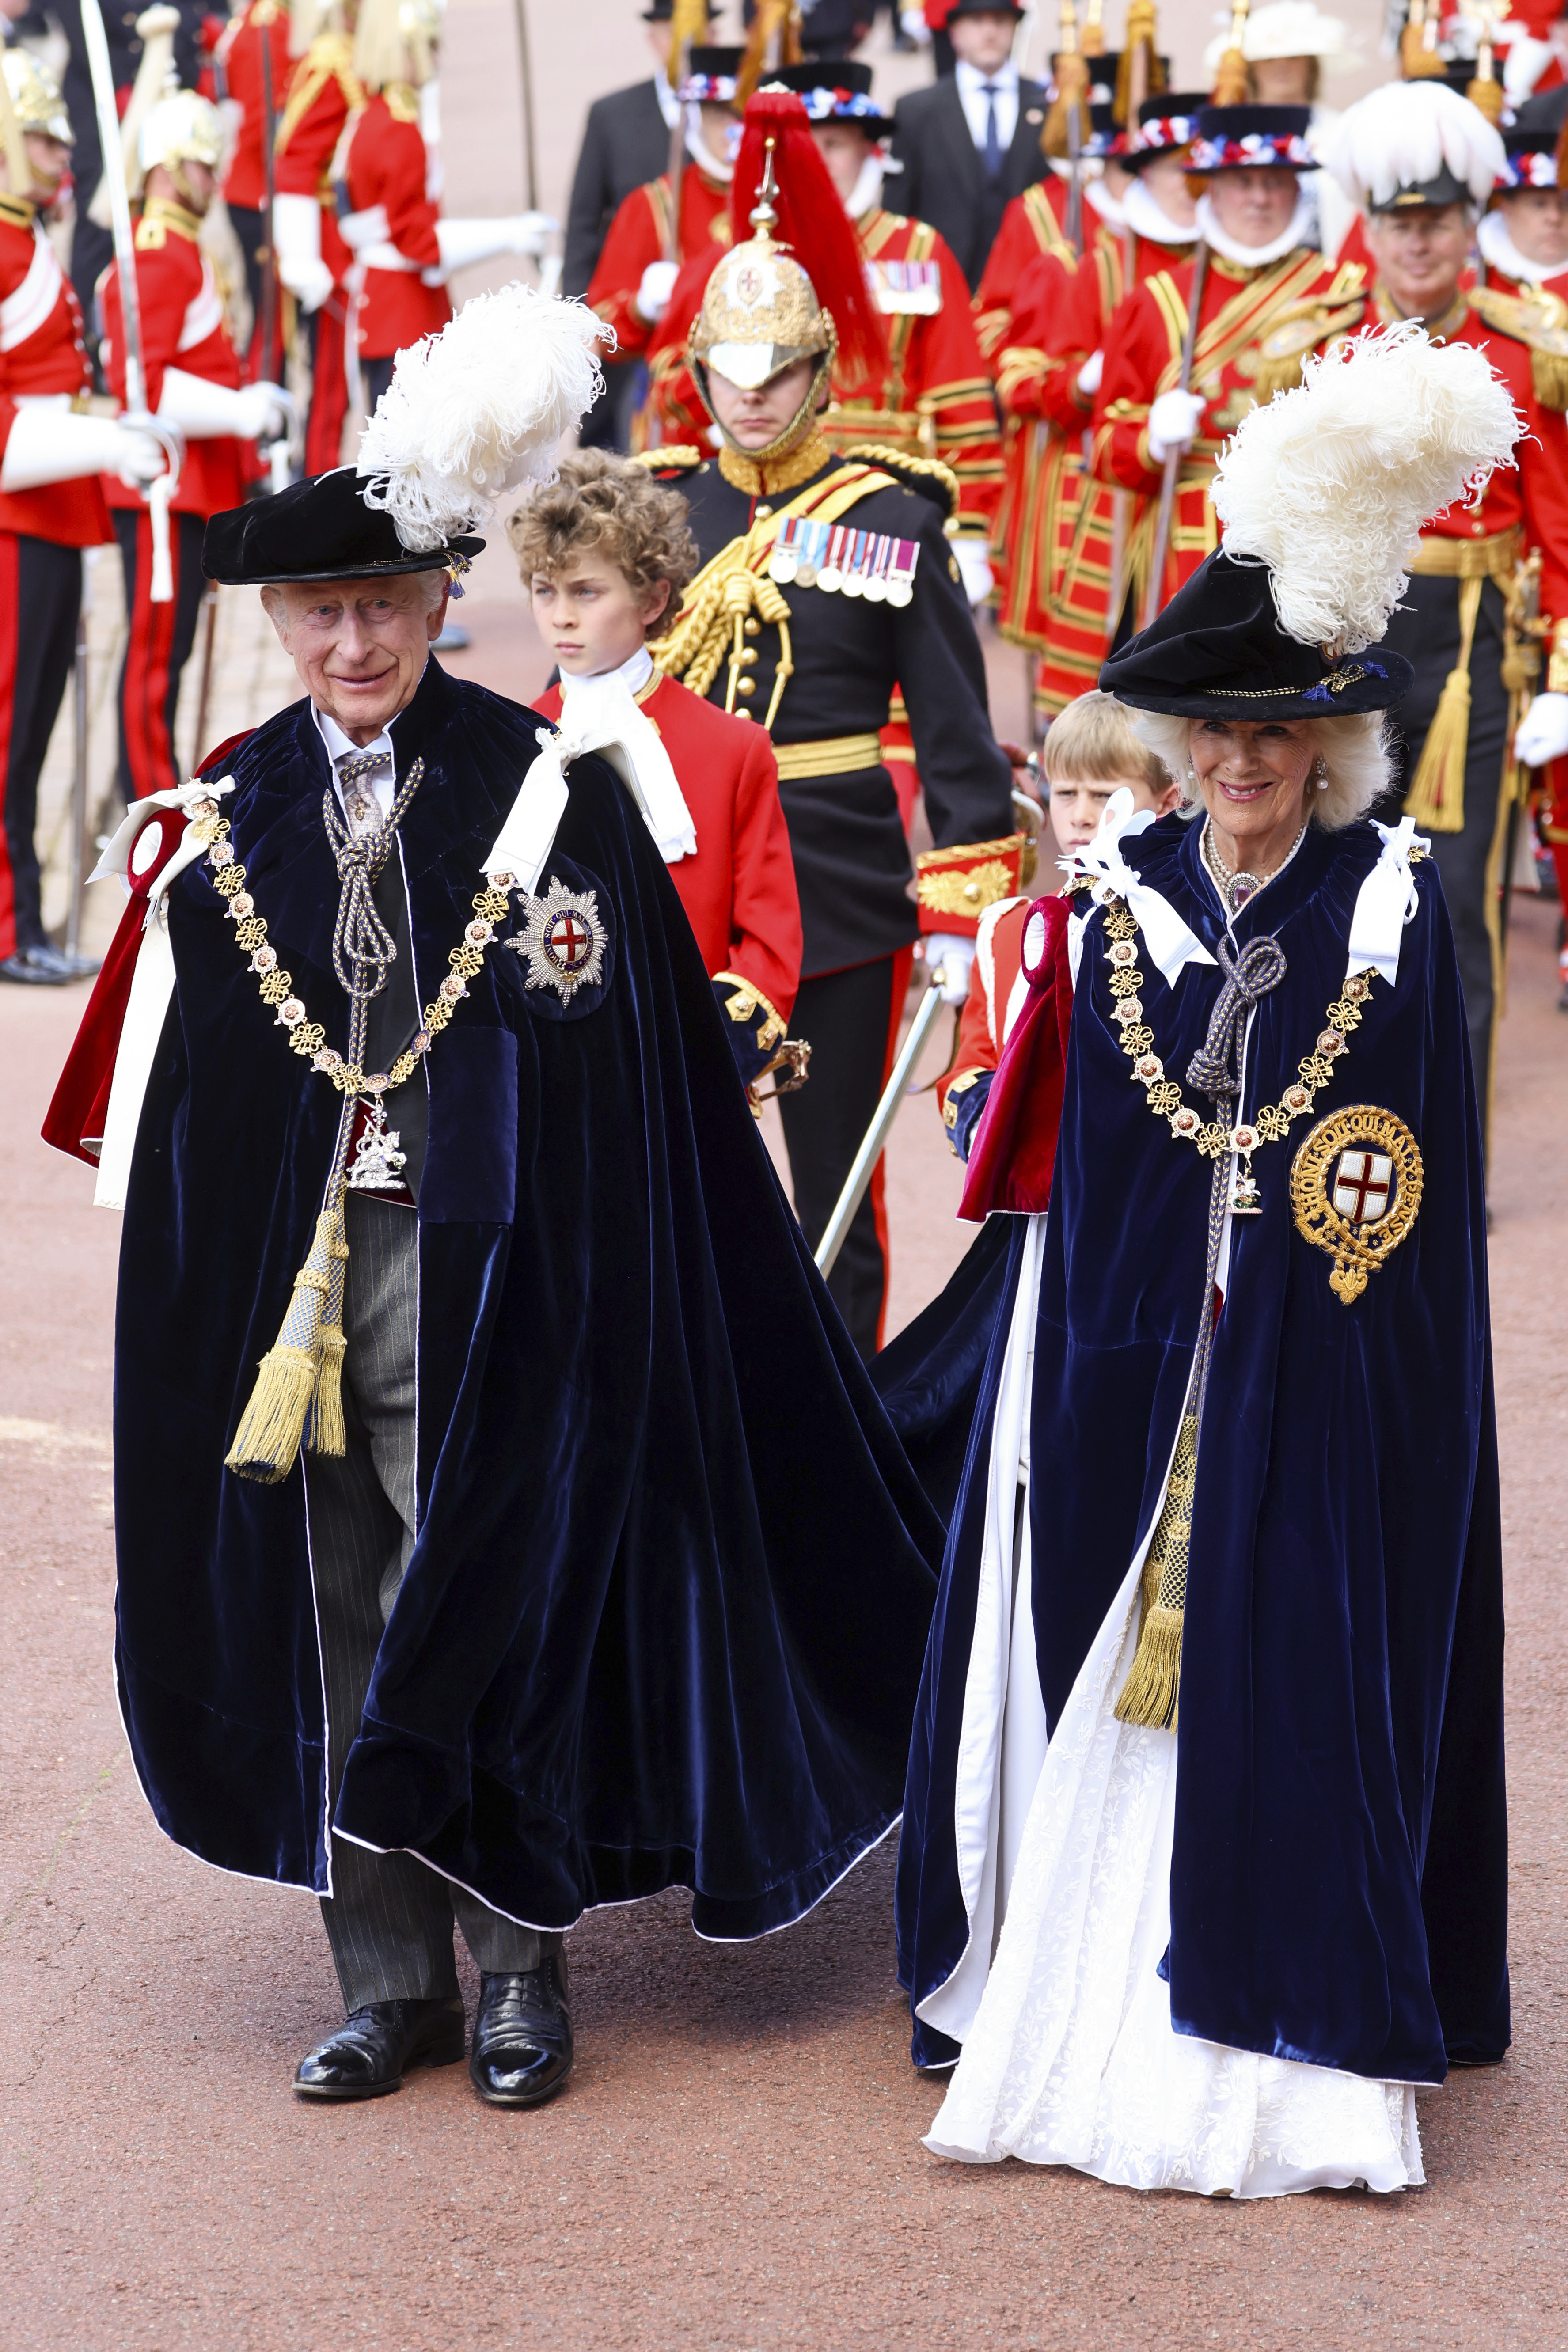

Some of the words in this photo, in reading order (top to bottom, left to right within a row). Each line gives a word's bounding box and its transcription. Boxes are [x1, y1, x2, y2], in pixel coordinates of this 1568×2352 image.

[556, 910, 569, 919] QUI
[544, 918, 556, 938] SOIT
[545, 944, 559, 964] HONI
[1350, 1114, 1380, 1134] QUI
[1313, 1119, 1351, 1157] SOIT
[1378, 1119, 1413, 1162] MAL
[1405, 1159, 1418, 1177] Y
[1300, 1153, 1323, 1210] HONI
[1378, 1179, 1418, 1244] PENSE
